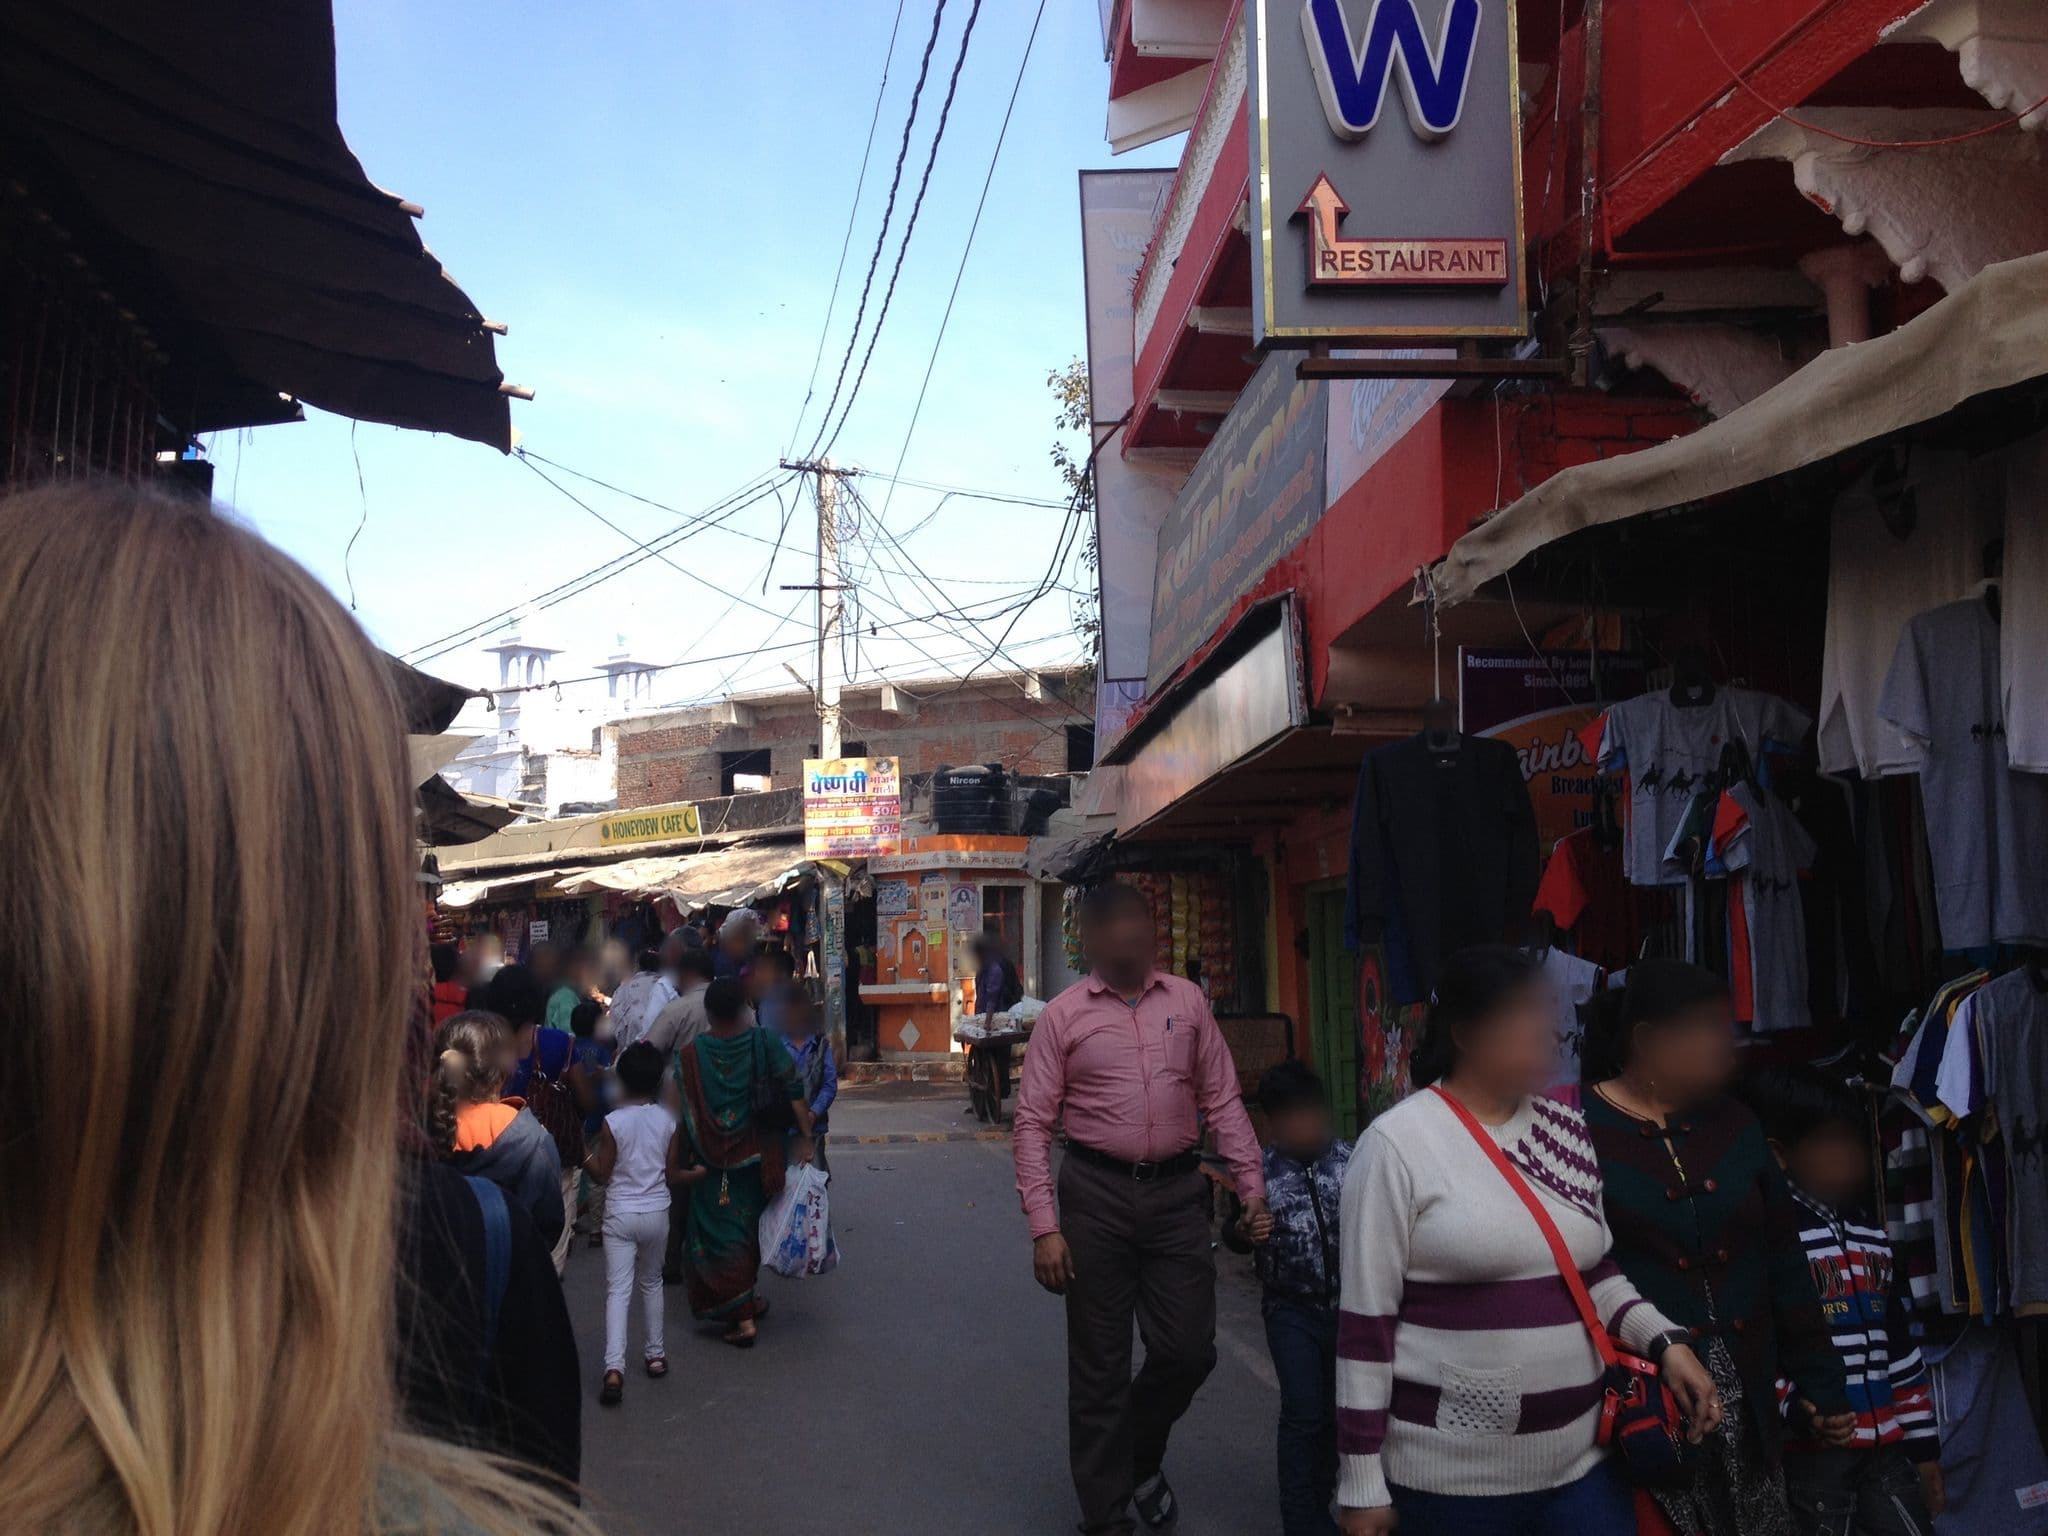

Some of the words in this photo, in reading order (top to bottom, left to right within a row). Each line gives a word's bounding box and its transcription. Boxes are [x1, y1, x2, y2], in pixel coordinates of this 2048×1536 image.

[1301, 0, 1481, 141] W
[1321, 249, 1500, 273] RESTAURANT
[1282, 510, 1309, 550] Food
[1466, 654, 1547, 669] Recommended
[950, 776, 981, 785] Nircon
[612, 817, 659, 839] HONEYDEW
[871, 824, 899, 835] 90/-
